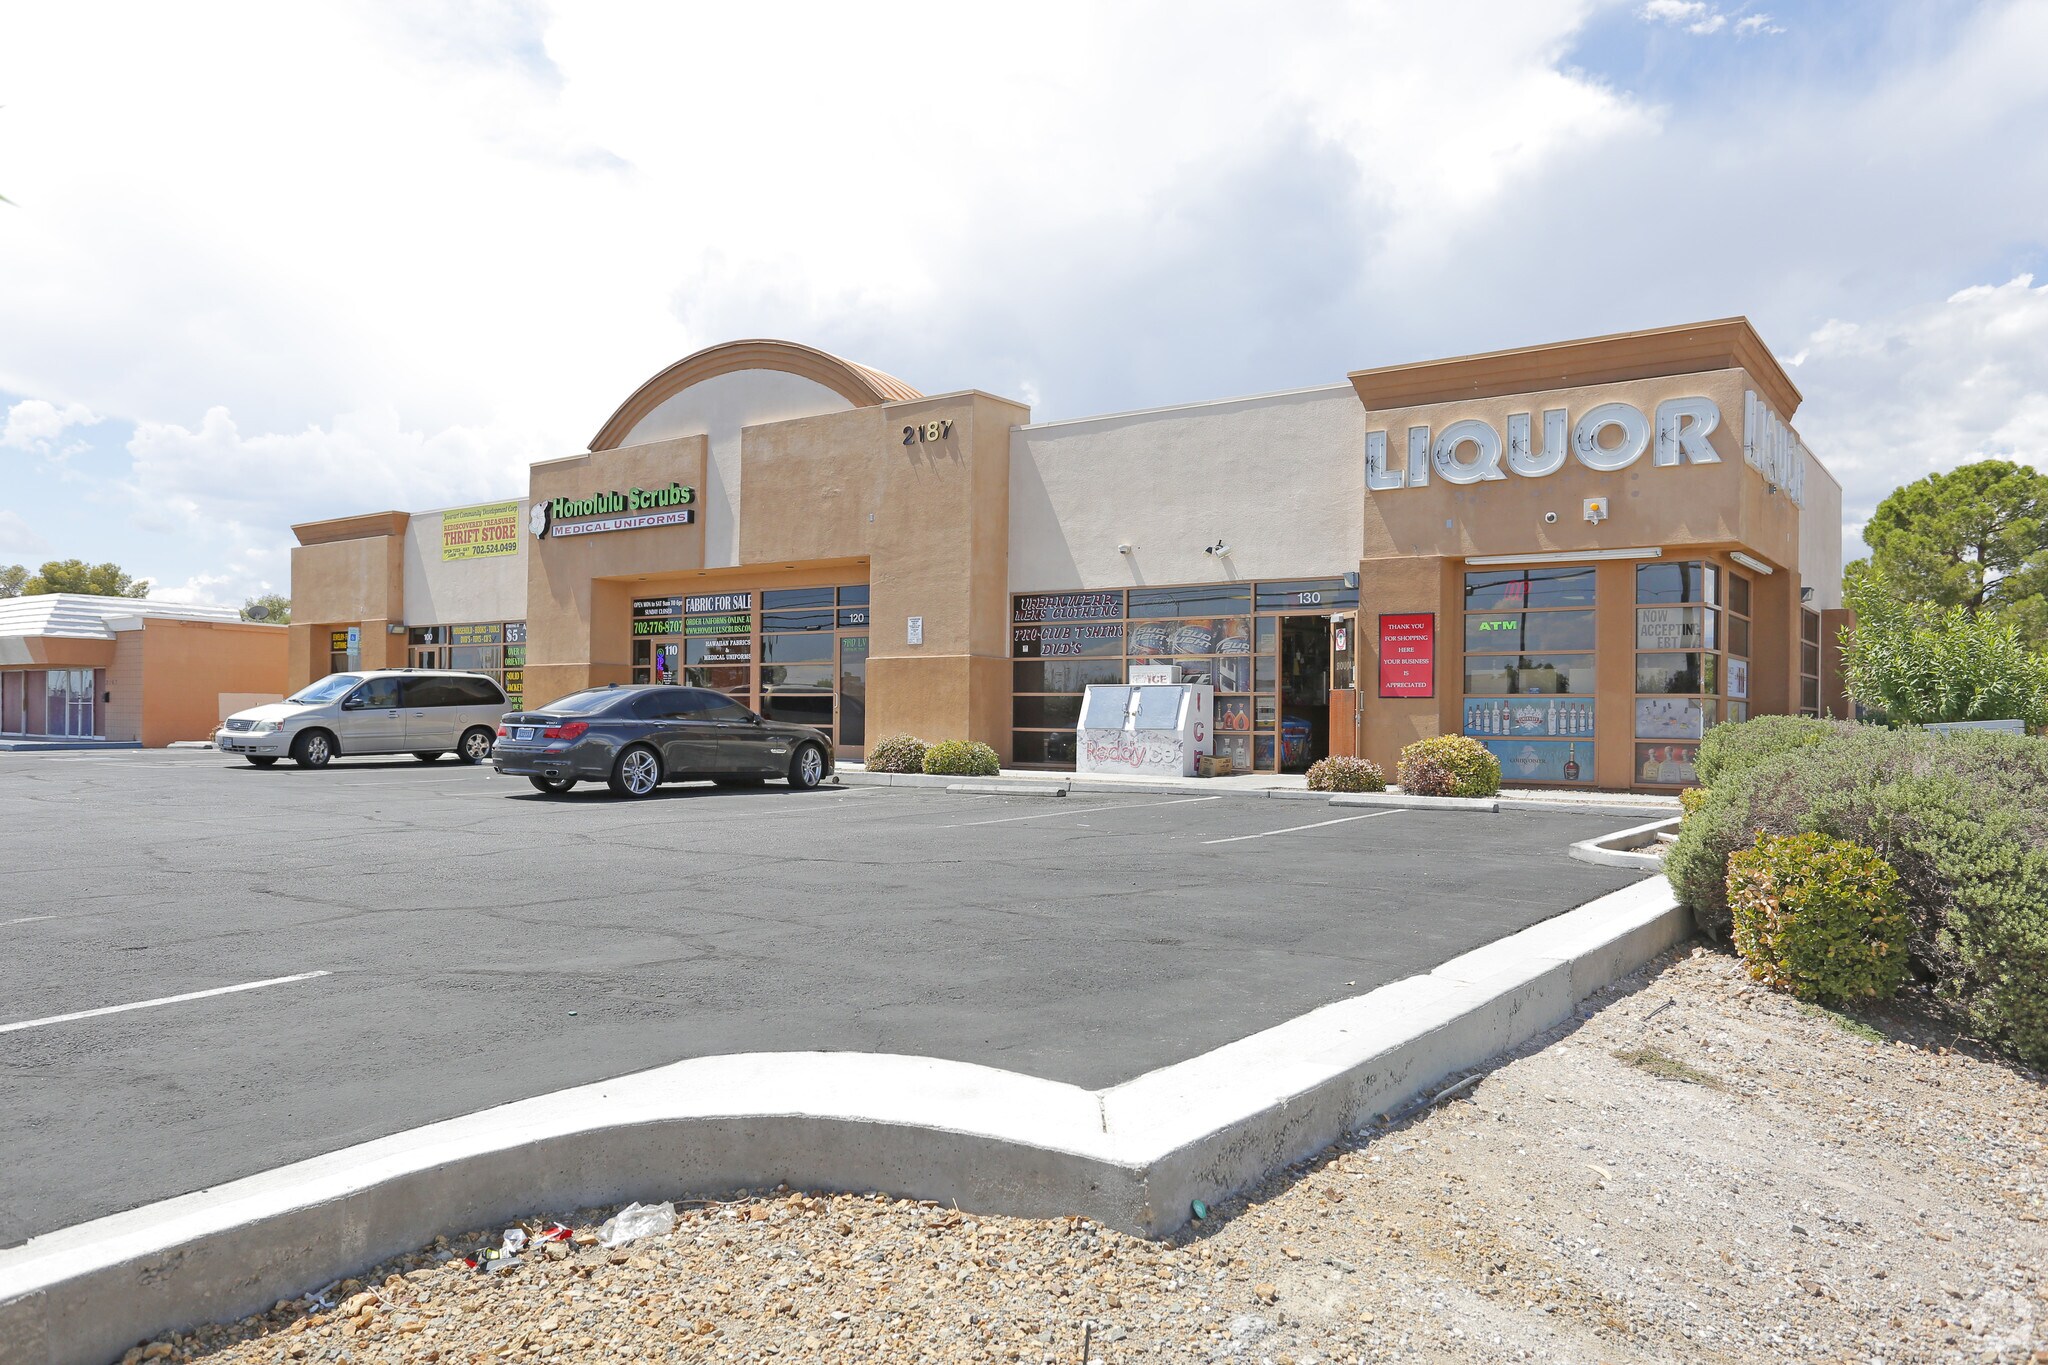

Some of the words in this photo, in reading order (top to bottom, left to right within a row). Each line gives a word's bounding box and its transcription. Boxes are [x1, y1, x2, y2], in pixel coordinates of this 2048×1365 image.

[902, 419, 953, 445] 2187
[1365, 395, 1721, 491] LIQUOR
[553, 491, 626, 519] Honolulu
[628, 482, 693, 510] Scrubs
[444, 521, 483, 531] REDISCOVERED
[484, 516, 516, 526] TREASURES
[554, 523, 610, 536] MEDICAL
[614, 513, 686, 529] UNIFORMS
[444, 528, 480, 546] THRIFT
[482, 524, 516, 541] STORE
[472, 542, 517, 555] 702.524.0499
[686, 597, 714, 612] FABRIC
[715, 595, 731, 610] FOR
[732, 595, 751, 609] SALE
[1298, 592, 1320, 604] 130
[849, 613, 865, 623] 120
[1014, 609, 1046, 621] MENS
[1052, 606, 1119, 619] CLOTHING
[1643, 610, 1668, 622] NOW
[686, 617, 702, 625] ORDER
[703, 617, 726, 625] UNIFORMS
[728, 616, 745, 624] ONLINE
[1479, 620, 1517, 631] ATM
[506, 629, 518, 642] $5
[1181, 629, 1212, 641] BUD
[1641, 623, 1701, 636] ACCEPTING
[424, 633, 433, 641] 100
[1657, 637, 1679, 648] EBT
[508, 647, 519, 655] OVER
[665, 645, 678, 655] 110
[1221, 641, 1250, 650] BUD
[507, 672, 520, 680] SOLID
[1086, 740, 1147, 768] Reddy
